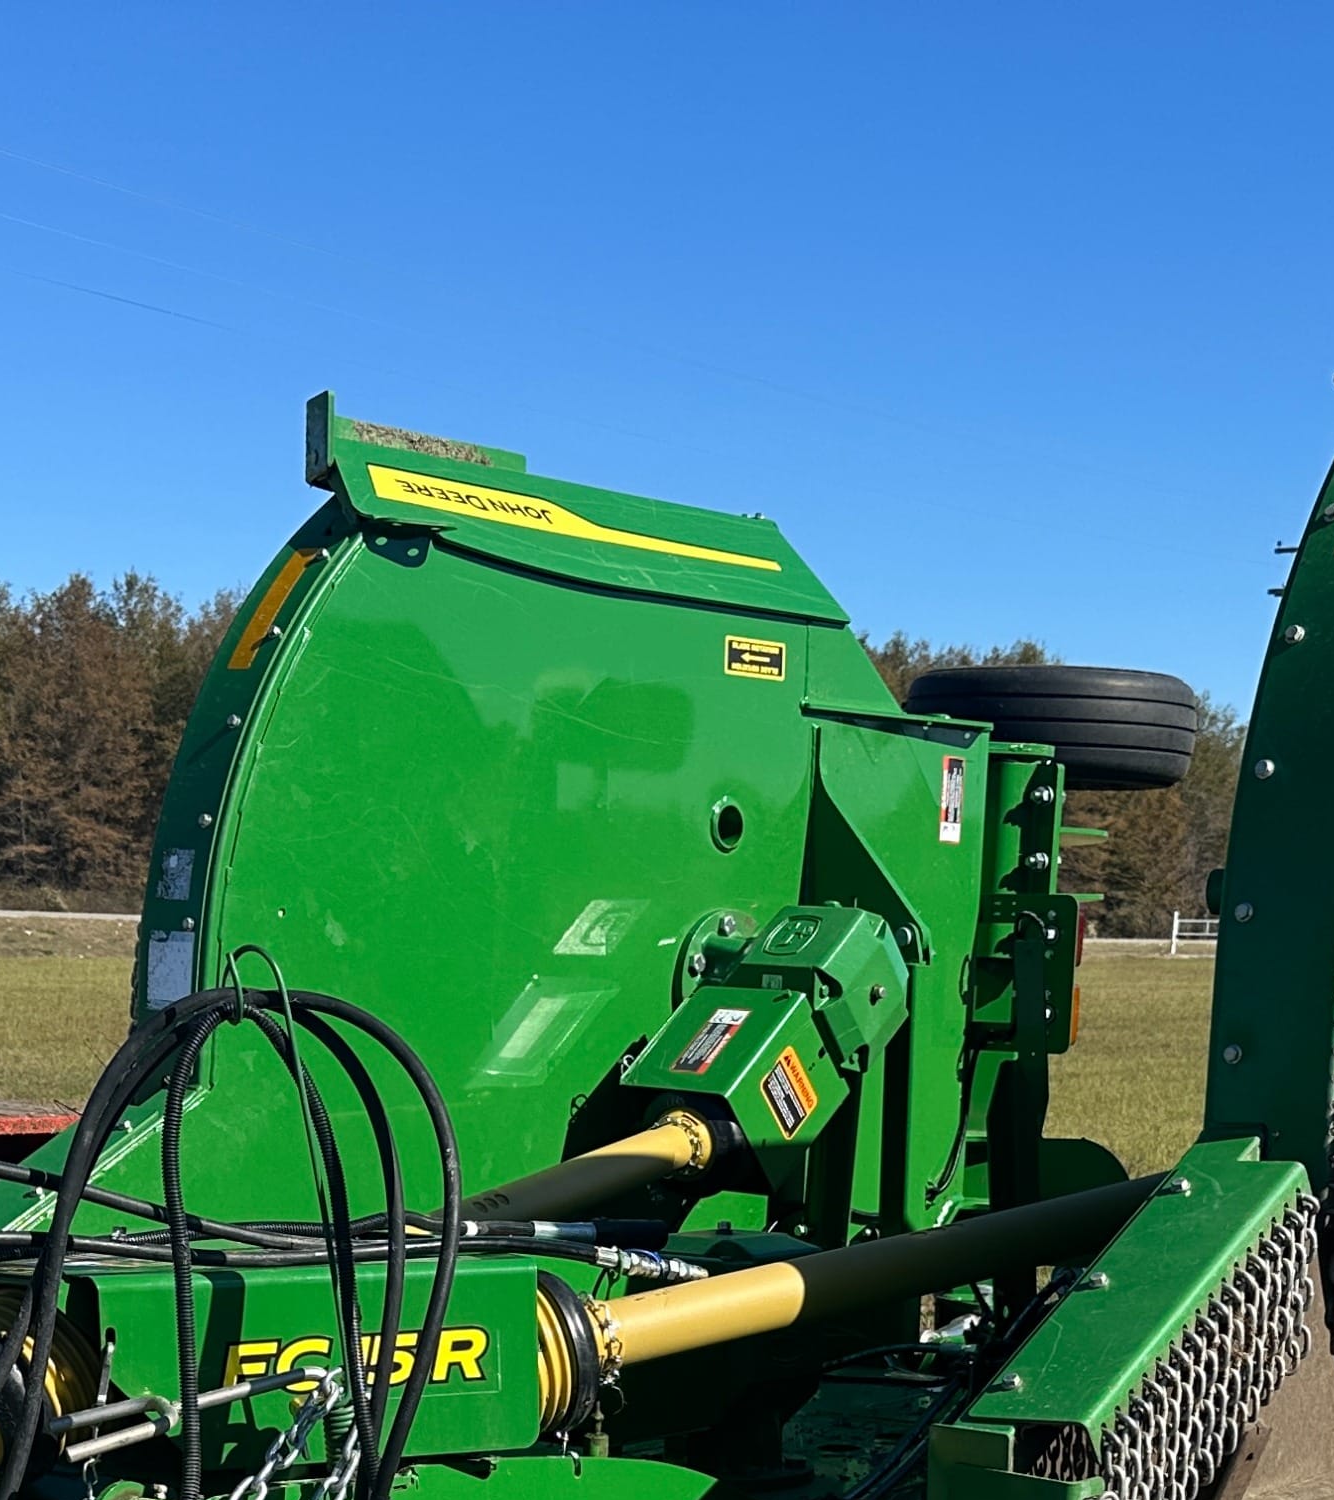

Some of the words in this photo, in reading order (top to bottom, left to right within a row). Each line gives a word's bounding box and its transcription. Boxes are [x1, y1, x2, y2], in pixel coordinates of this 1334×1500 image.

[394, 478, 489, 511] DEERE
[487, 497, 553, 525] JOHN
[789, 1064, 814, 1109] WARNING
